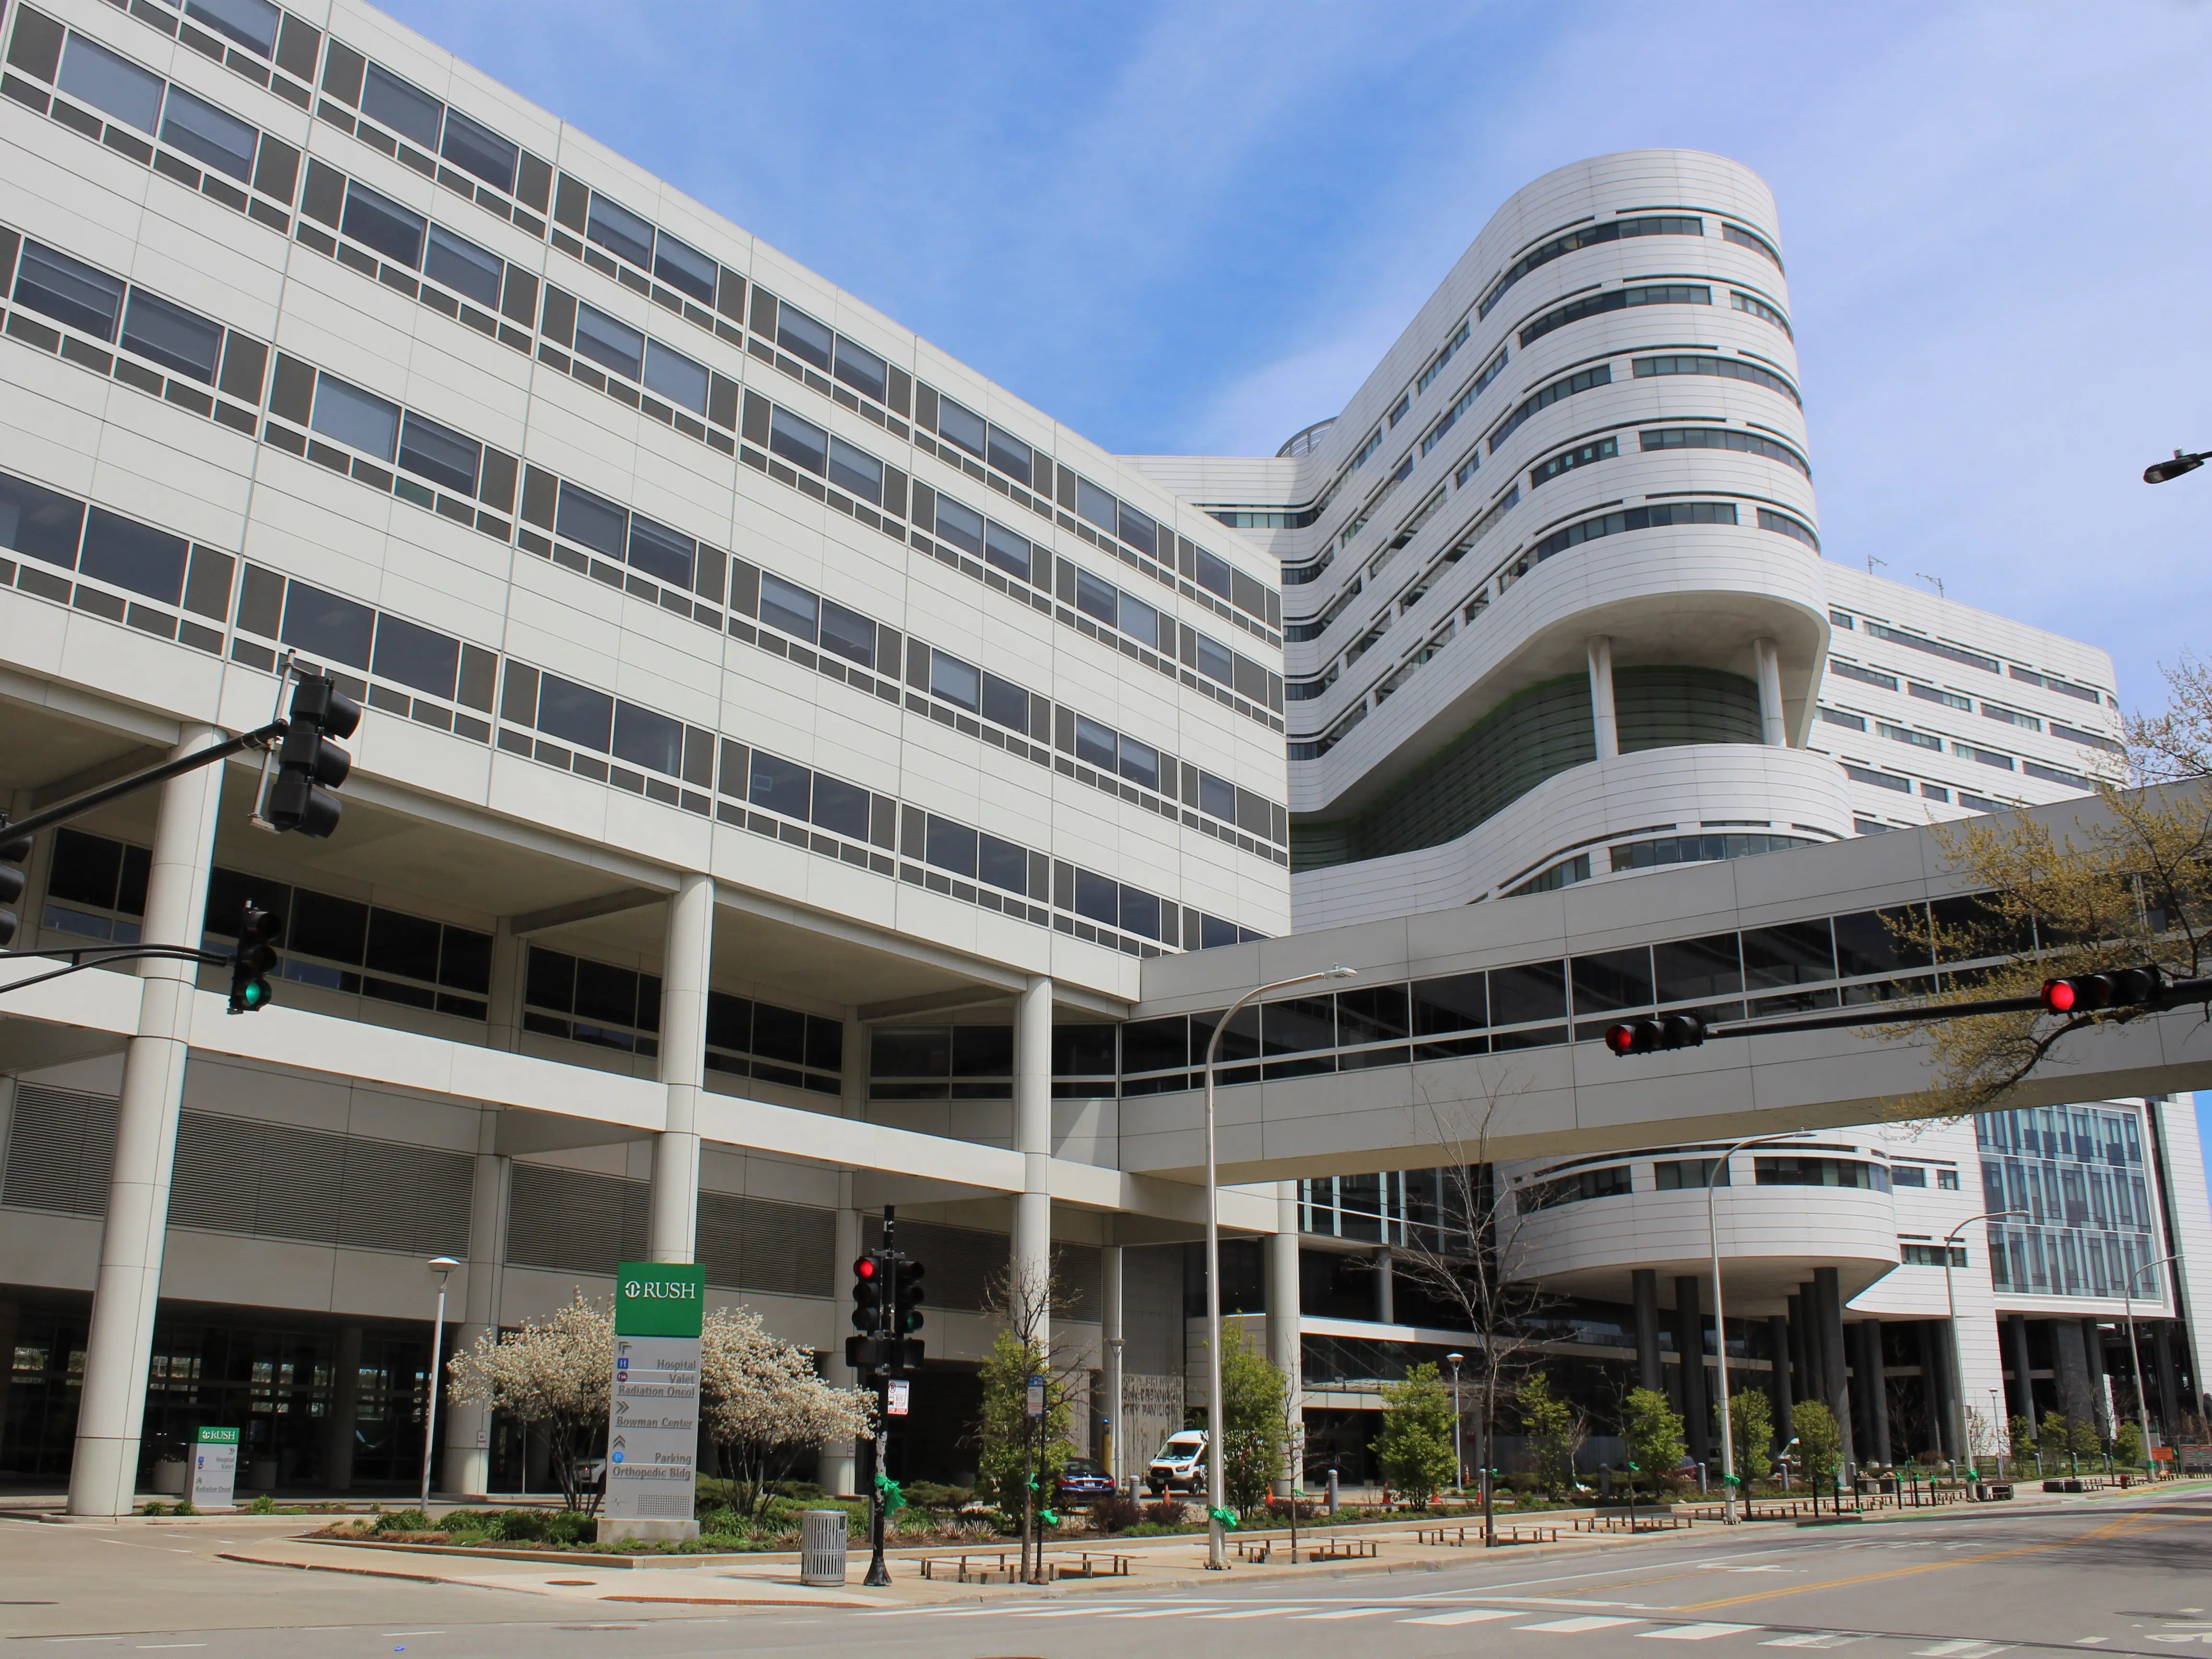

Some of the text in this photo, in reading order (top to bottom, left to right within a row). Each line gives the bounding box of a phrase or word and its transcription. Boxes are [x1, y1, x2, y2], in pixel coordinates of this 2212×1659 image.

[643, 1282, 696, 1299] RUSH
[657, 1359, 696, 1373] Hospital
[669, 1373, 695, 1384] Valet
[618, 1385, 695, 1397] Radiation Oncol
[616, 1416, 693, 1428] Bowman Center
[211, 1431, 236, 1440] RUSH
[655, 1453, 691, 1466] Parking
[613, 1466, 691, 1481] Orthopedic Bldg
